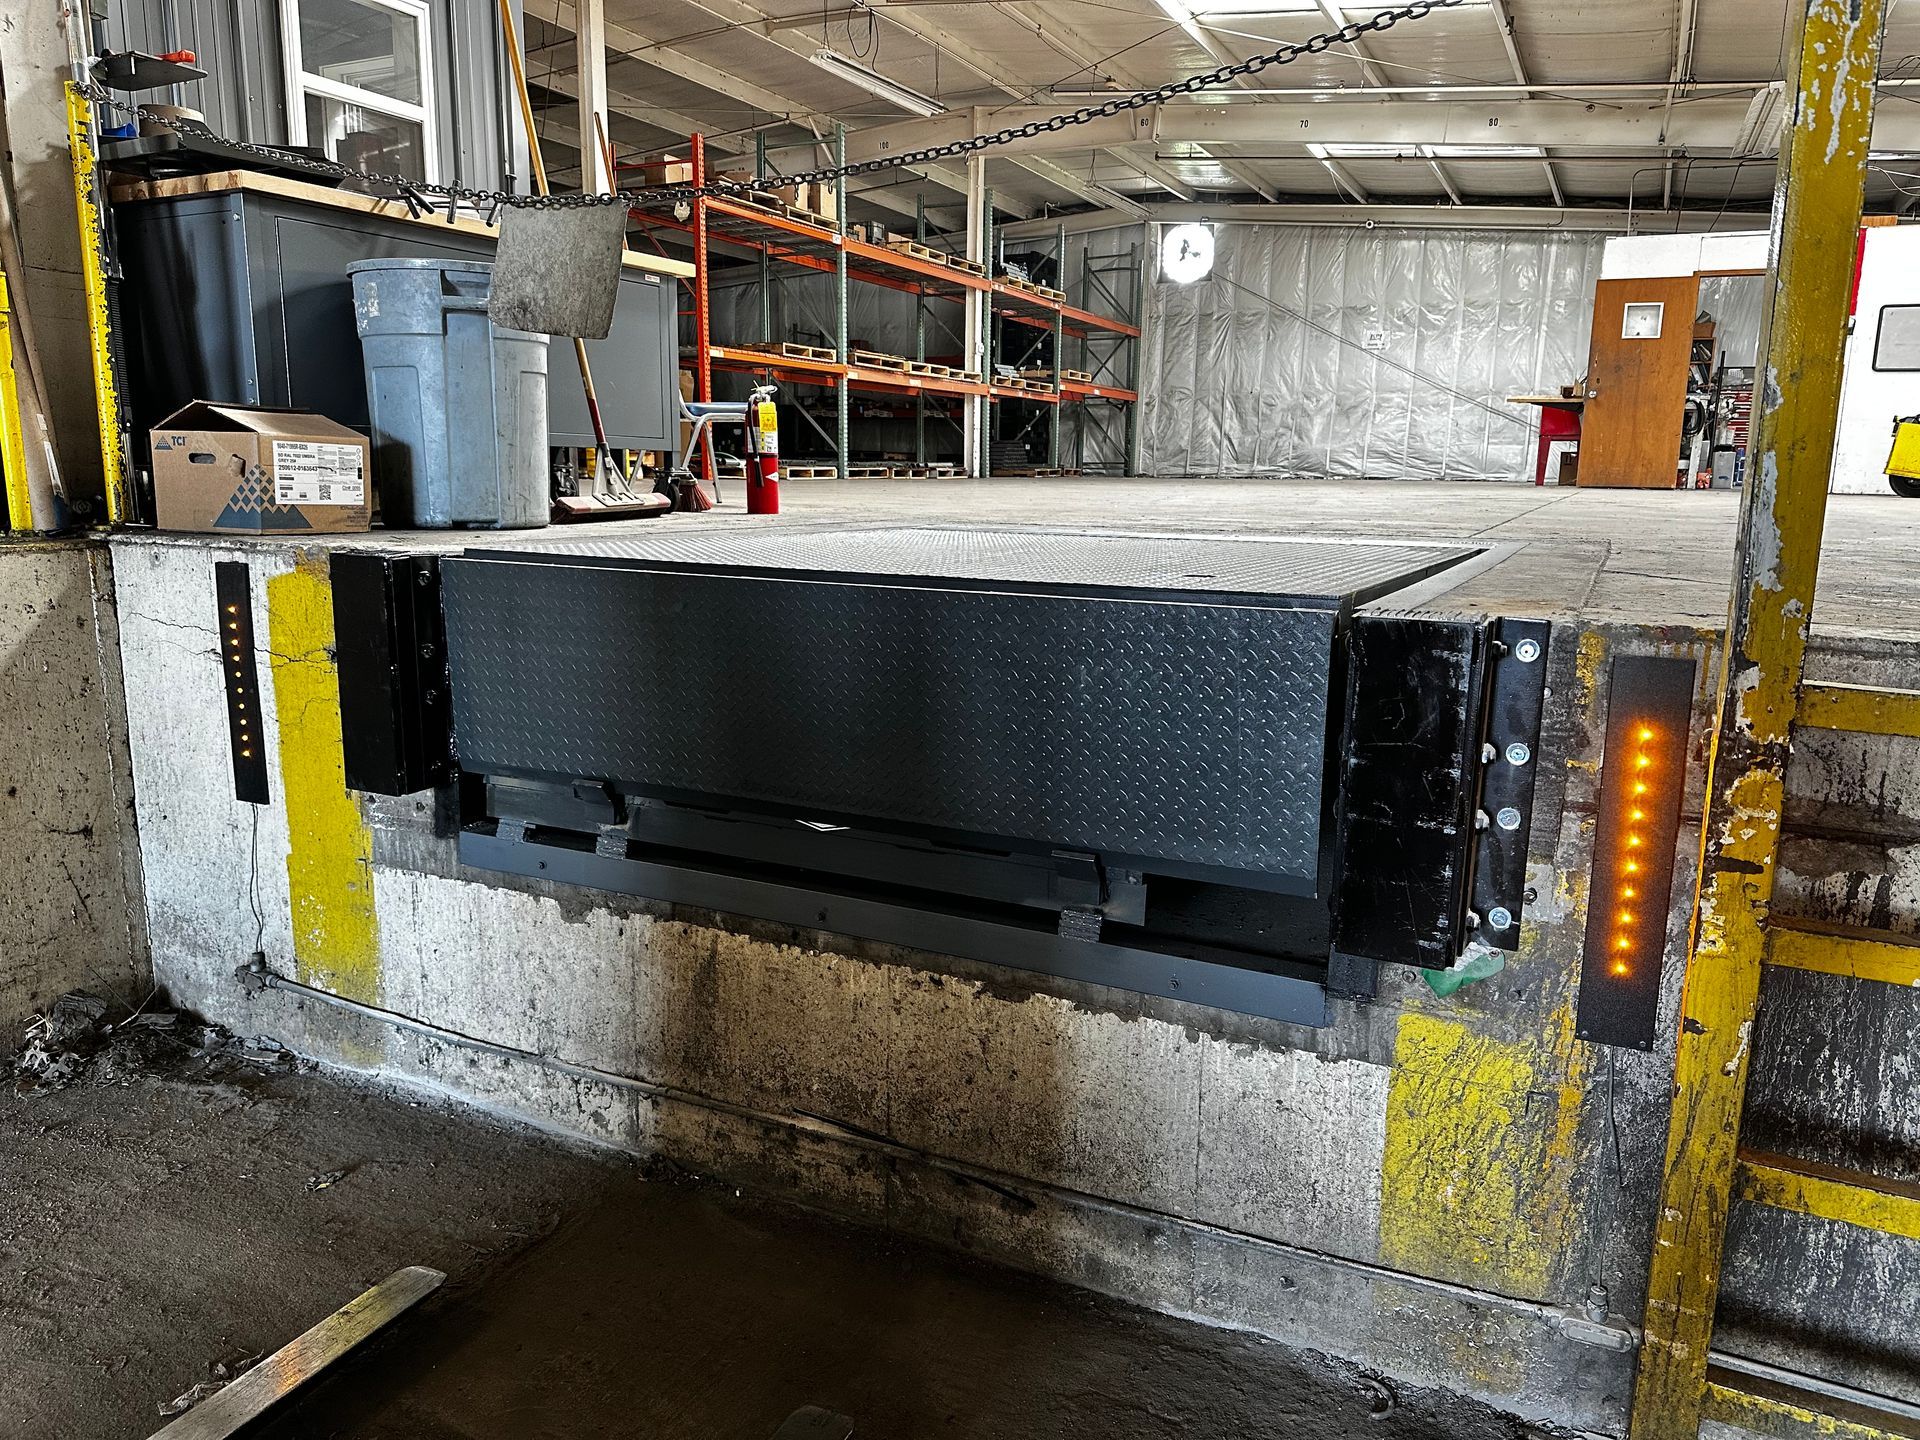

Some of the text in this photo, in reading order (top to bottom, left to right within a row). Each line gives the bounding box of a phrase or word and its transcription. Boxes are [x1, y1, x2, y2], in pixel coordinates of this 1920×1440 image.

[1300, 120, 1308, 128] 70
[1488, 117, 1499, 127] 80
[171, 435, 185, 446] TCI
